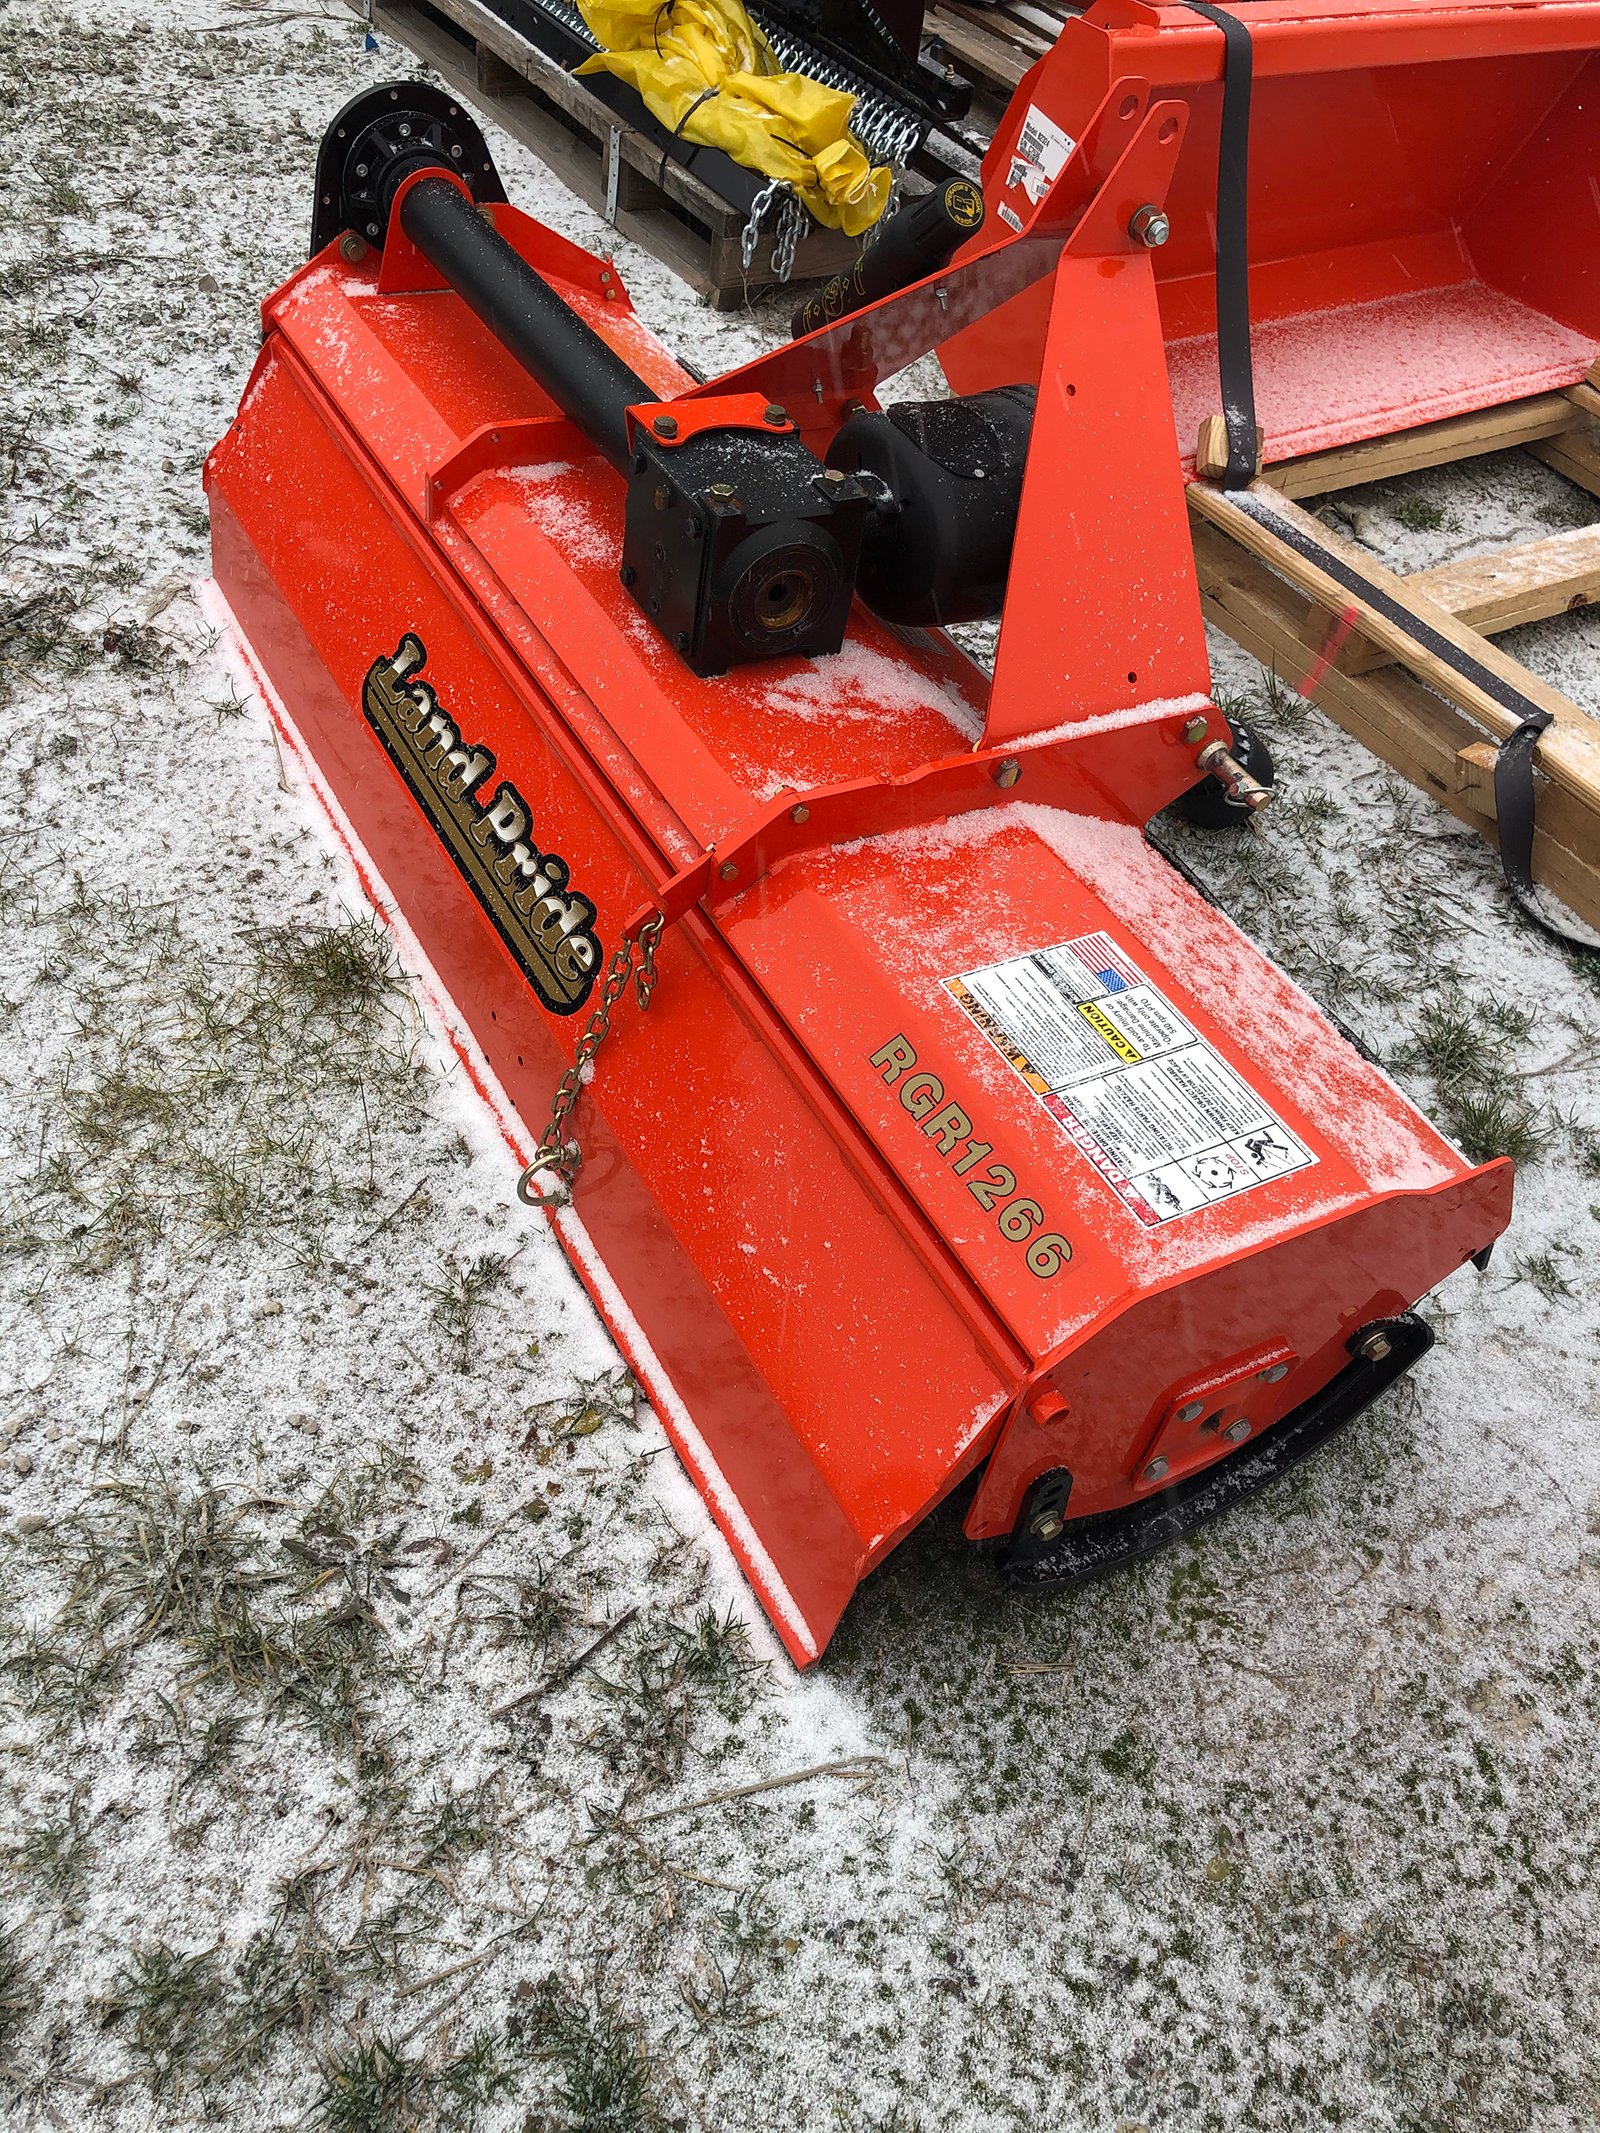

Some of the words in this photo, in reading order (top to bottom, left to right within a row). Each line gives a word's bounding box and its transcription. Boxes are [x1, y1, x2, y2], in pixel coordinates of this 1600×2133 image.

[376, 638, 493, 804] Land
[468, 788, 596, 982] Pride
[1103, 1002, 1115, 1010] or
[1122, 993, 1141, 1007] with
[1139, 997, 1157, 1011] PTO
[1134, 1005, 1152, 1020] only
[1150, 1009, 1169, 1023] rpm
[1082, 1004, 1128, 1049] CAUTION
[1124, 1026, 1145, 1043] avoid
[1135, 1022, 1163, 1048] Machine
[1162, 1022, 1178, 1034] 540
[1140, 1042, 1152, 1051] To
[1166, 1057, 1184, 1073] PLACE
[1164, 1066, 1188, 1088] HAZARD
[1184, 1087, 1207, 1108] OBJECT
[1185, 1078, 1214, 1106] DEFLECTOR
[1202, 1107, 1228, 1131] THROWN
[1209, 1105, 1229, 1122] FRONT
[1224, 1121, 1241, 1135] KEEP
[868, 1032, 1073, 1279] RGR1266
[1059, 1114, 1126, 1184] DANGER
[1224, 1152, 1250, 1176] STOP
